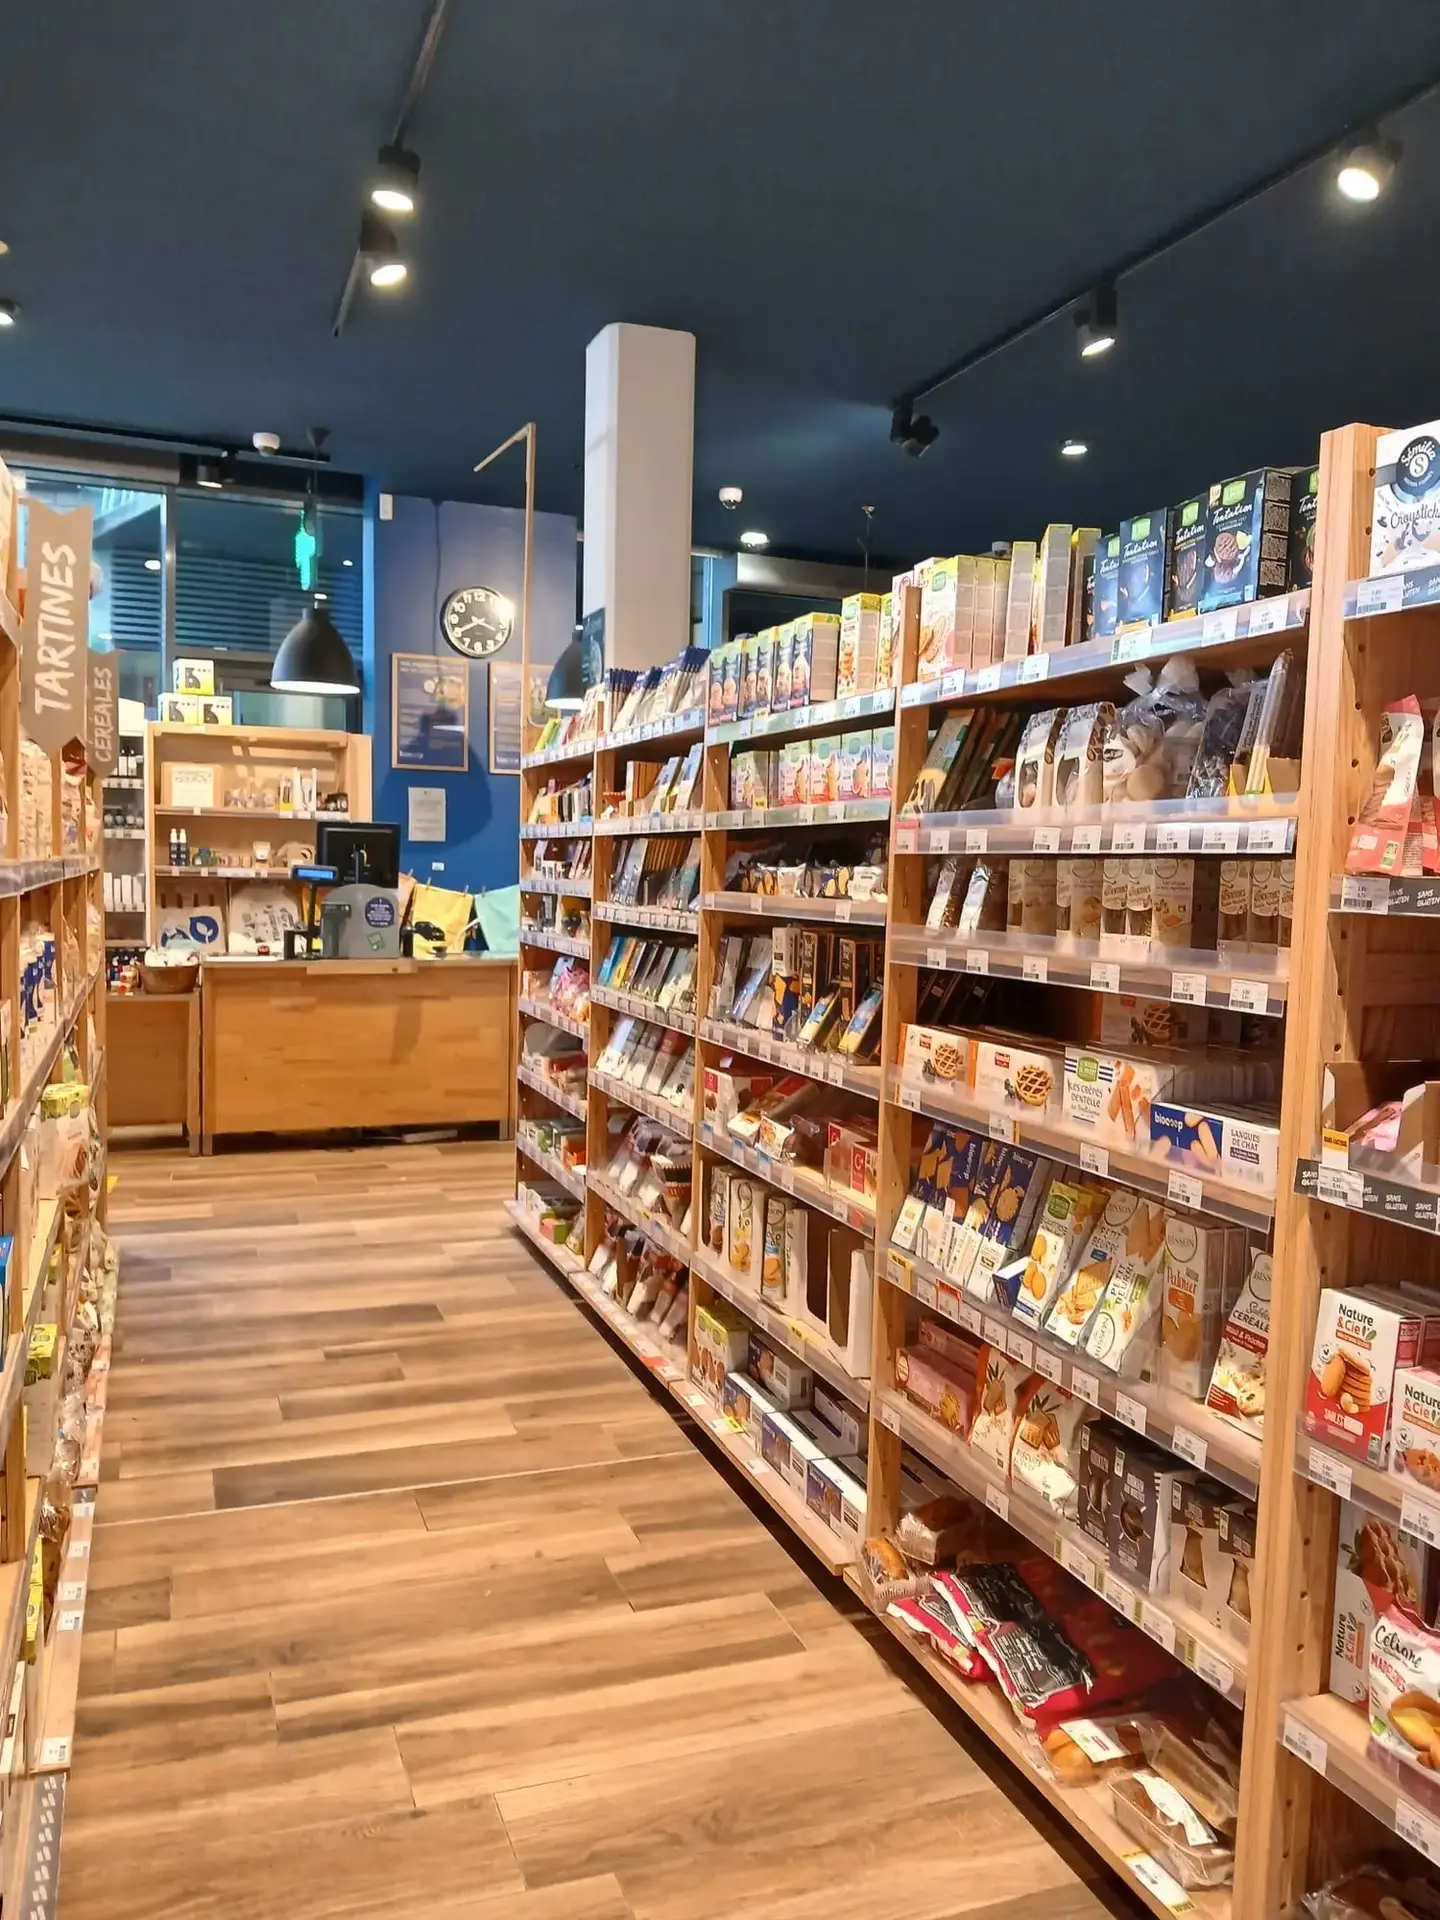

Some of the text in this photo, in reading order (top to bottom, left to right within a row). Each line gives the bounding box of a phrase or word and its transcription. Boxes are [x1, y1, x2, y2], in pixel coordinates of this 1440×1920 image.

[1413, 456, 1425, 474] S
[474, 592, 485, 601] 12
[34, 541, 77, 715] TARTINES
[89, 667, 112, 762] CÉRÉALES
[1417, 888, 1434, 899] SANS
[1231, 1129, 1260, 1143] LANGUES
[1384, 1202, 1408, 1211] GLUTEN
[1415, 1203, 1432, 1211] SANS
[1338, 1303, 1374, 1327] Nature
[1337, 1316, 1360, 1336] & Cie
[1403, 1400, 1430, 1420] & Cie
[1335, 1614, 1347, 1658] Nature
[1375, 1625, 1422, 1669] Céliane
